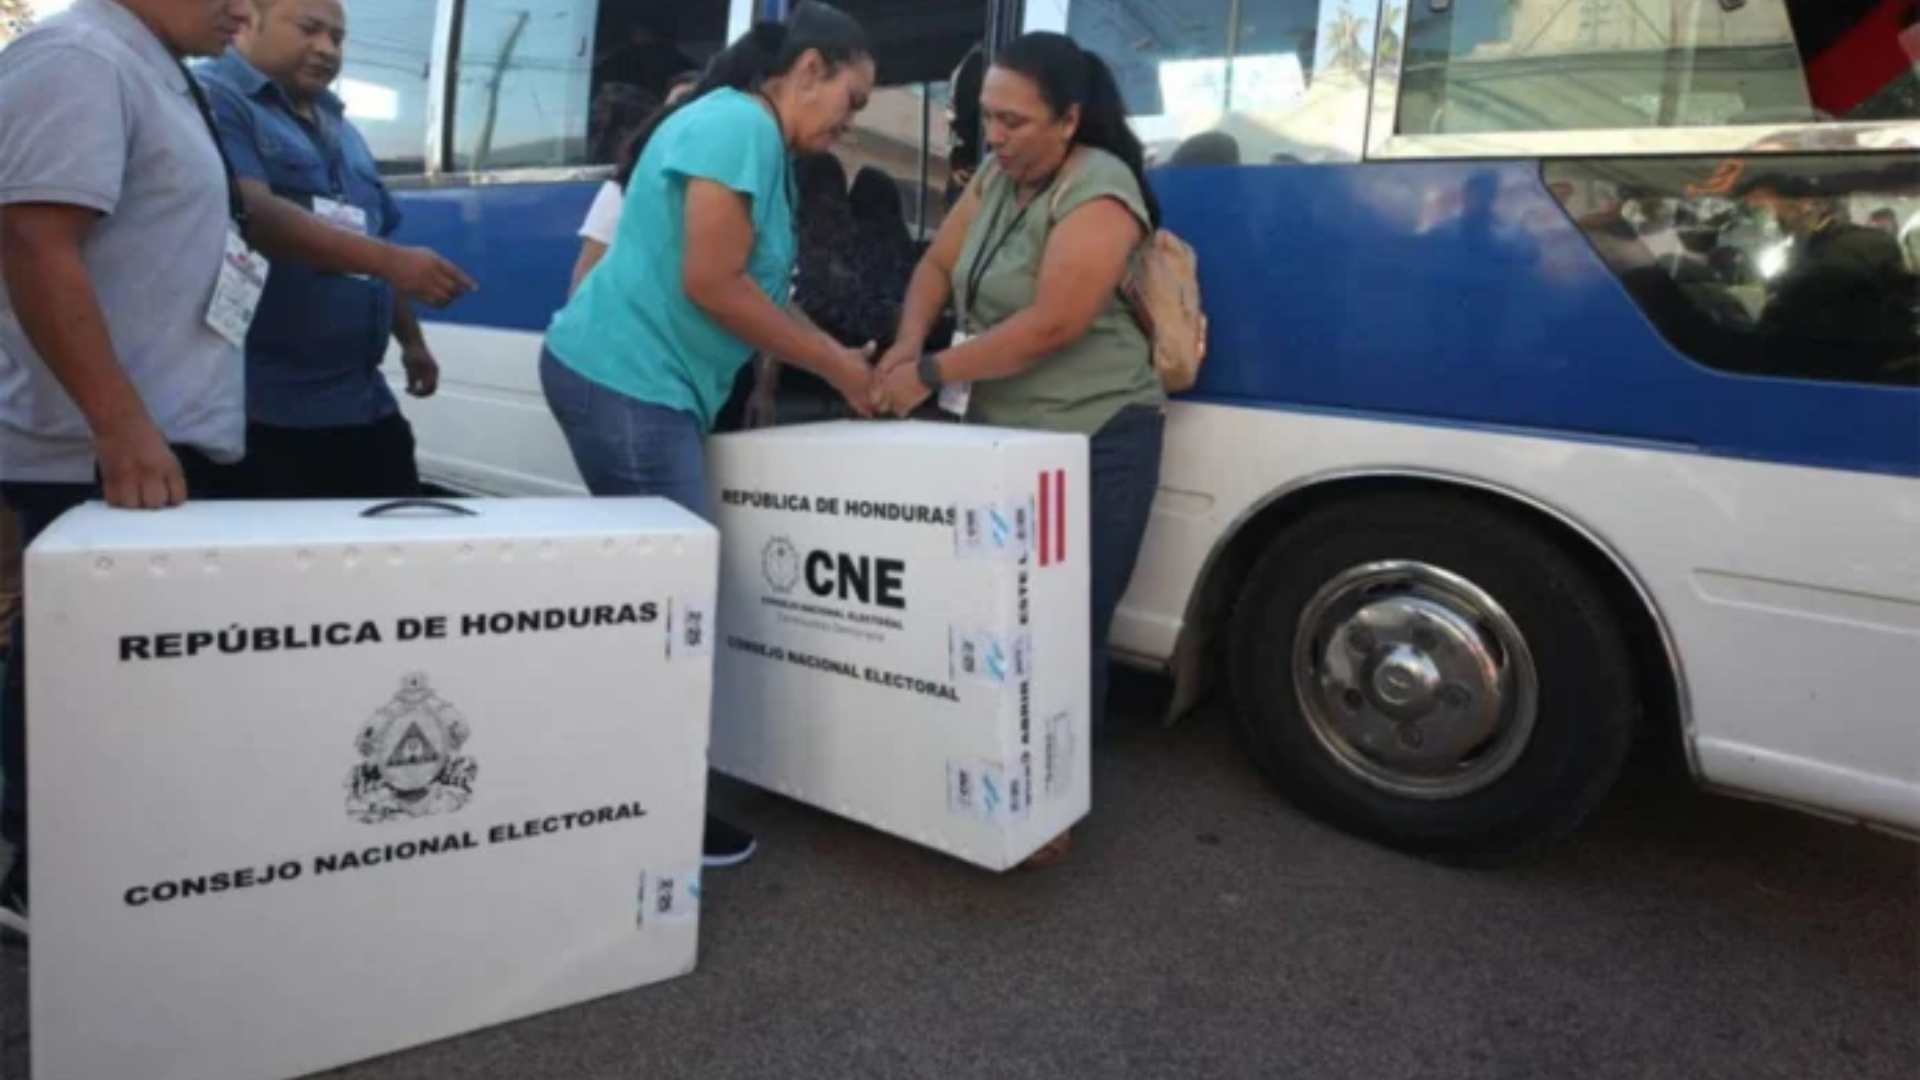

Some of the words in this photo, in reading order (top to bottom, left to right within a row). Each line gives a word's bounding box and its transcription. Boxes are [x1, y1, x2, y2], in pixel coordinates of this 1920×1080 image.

[815, 496, 840, 516] DE
[845, 499, 955, 526] HONDURAS
[804, 548, 907, 610] CNE
[118, 620, 382, 662] REPÚBLICA
[396, 615, 447, 642] DE
[460, 601, 658, 637] HONDURAS
[787, 649, 861, 680] NACIONAL
[863, 667, 961, 703] ELECTORAL
[123, 860, 303, 907] CONSEJO
[313, 830, 479, 875] NACIONAL
[487, 801, 647, 844] ELECTORAL
